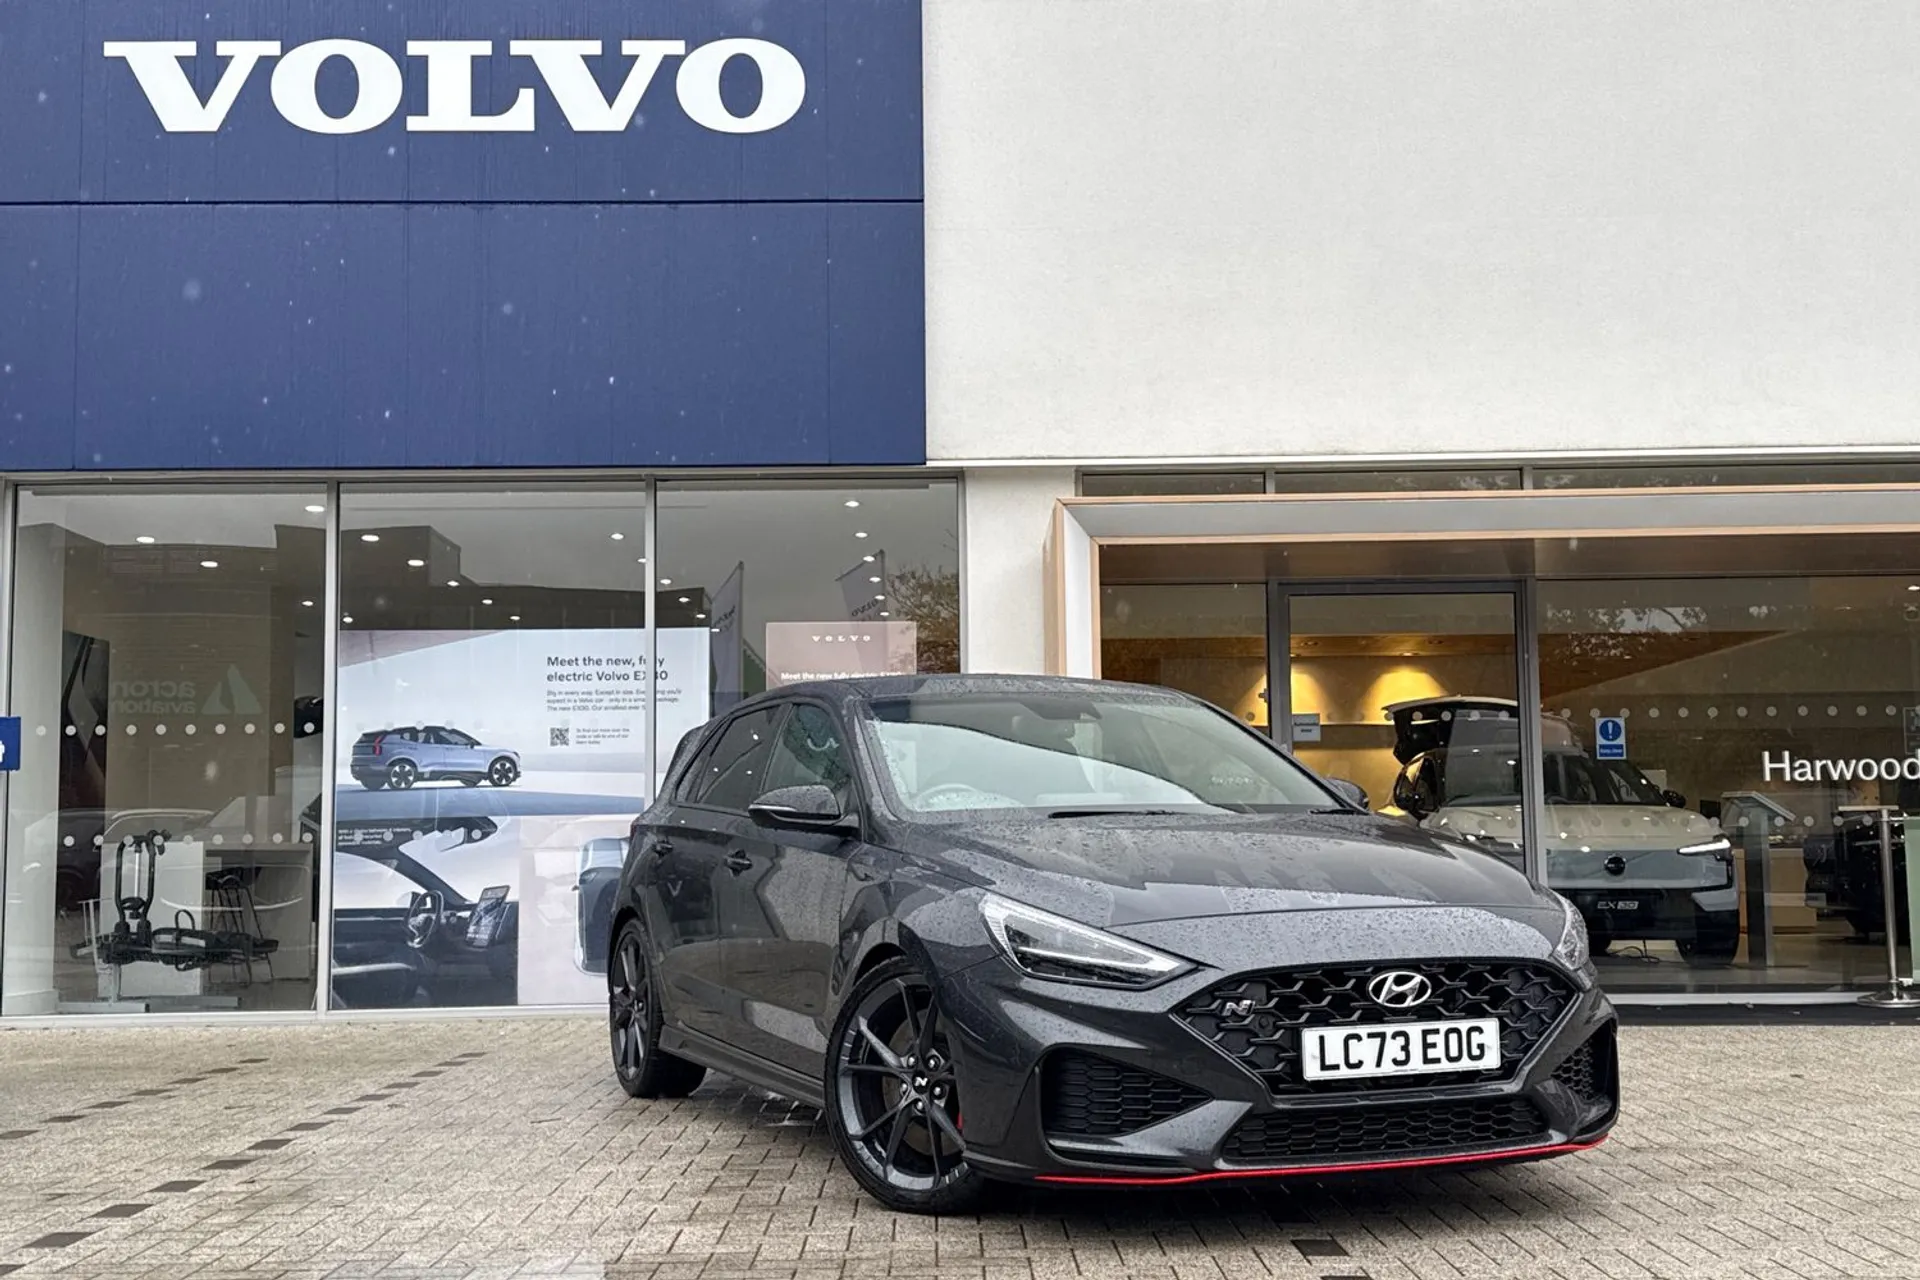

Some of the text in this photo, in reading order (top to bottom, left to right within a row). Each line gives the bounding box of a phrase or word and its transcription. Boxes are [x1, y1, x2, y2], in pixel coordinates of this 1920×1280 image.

[103, 38, 806, 135] VOLVO
[546, 671, 593, 682] electric
[596, 670, 630, 681] Volvo
[547, 656, 579, 667] Meet
[582, 655, 603, 667] the
[606, 657, 635, 668] new,
[1761, 748, 1920, 782] Harwood
[1318, 1025, 1486, 1072] LC73 EOG
